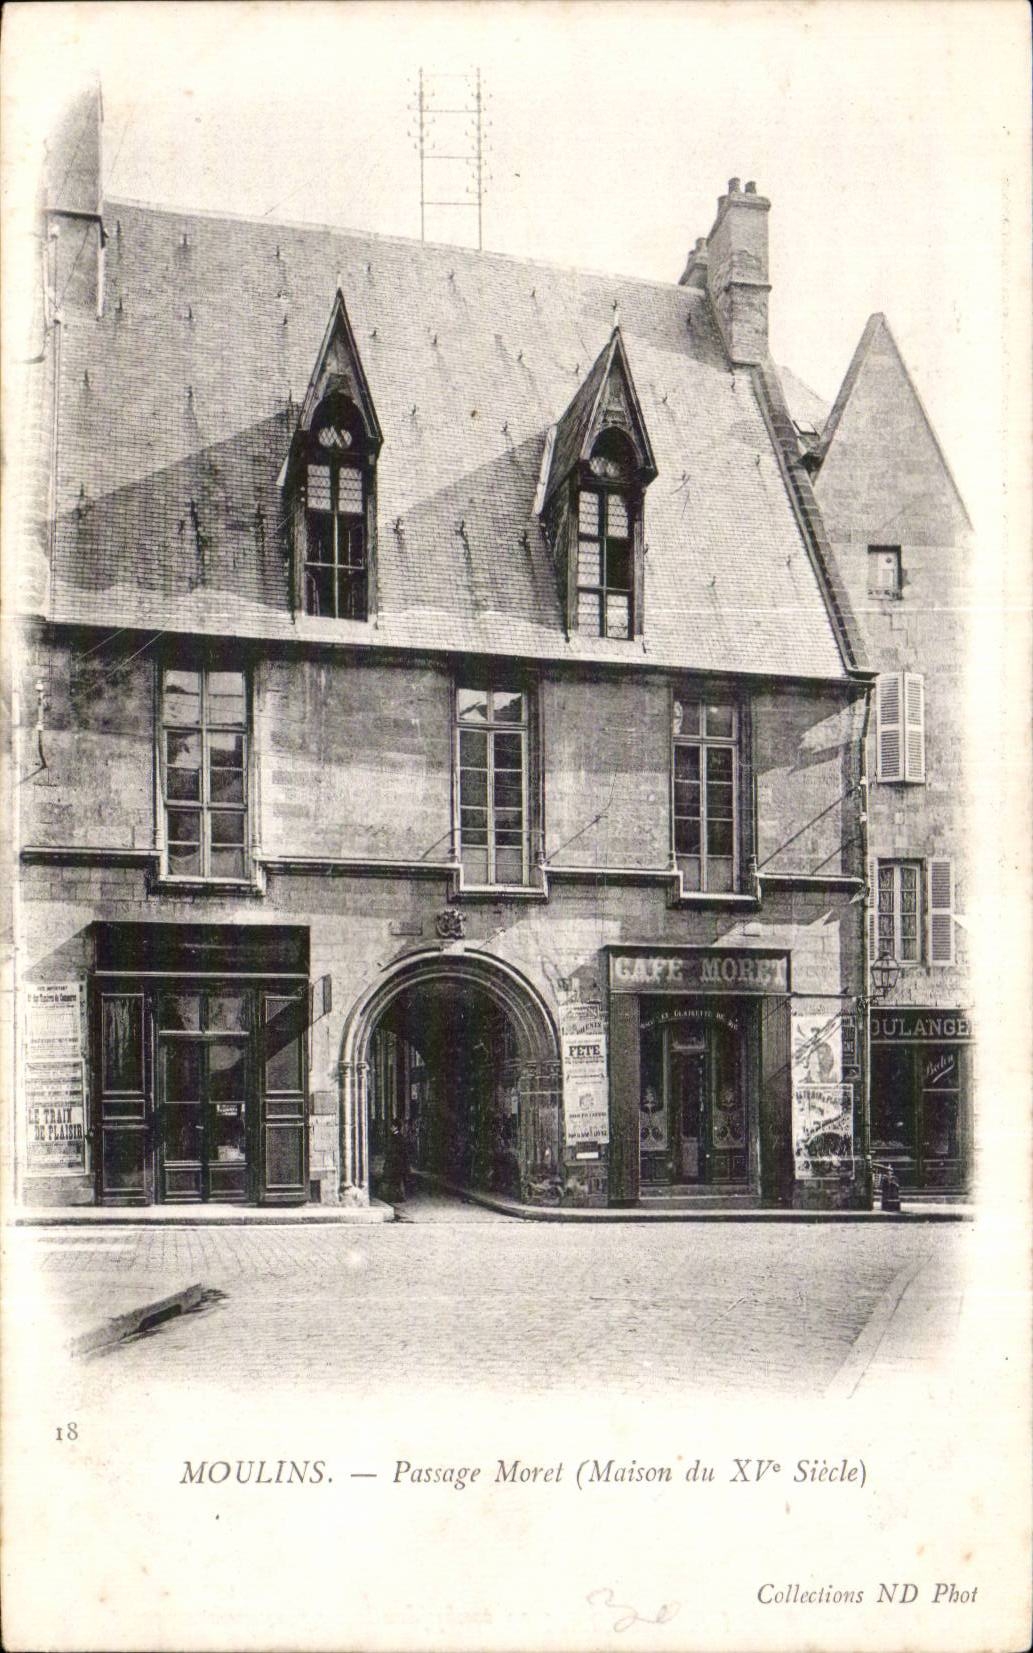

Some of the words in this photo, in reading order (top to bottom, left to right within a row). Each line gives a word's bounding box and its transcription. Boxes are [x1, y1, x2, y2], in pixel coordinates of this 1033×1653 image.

[699, 957, 787, 984] MORET
[870, 1018, 972, 1037] OULANGE
[28, 1108, 40, 1124] LE
[44, 1108, 72, 1124] TRAIN
[34, 1125, 46, 1141] DE
[48, 1123, 83, 1141] PLAISIR
